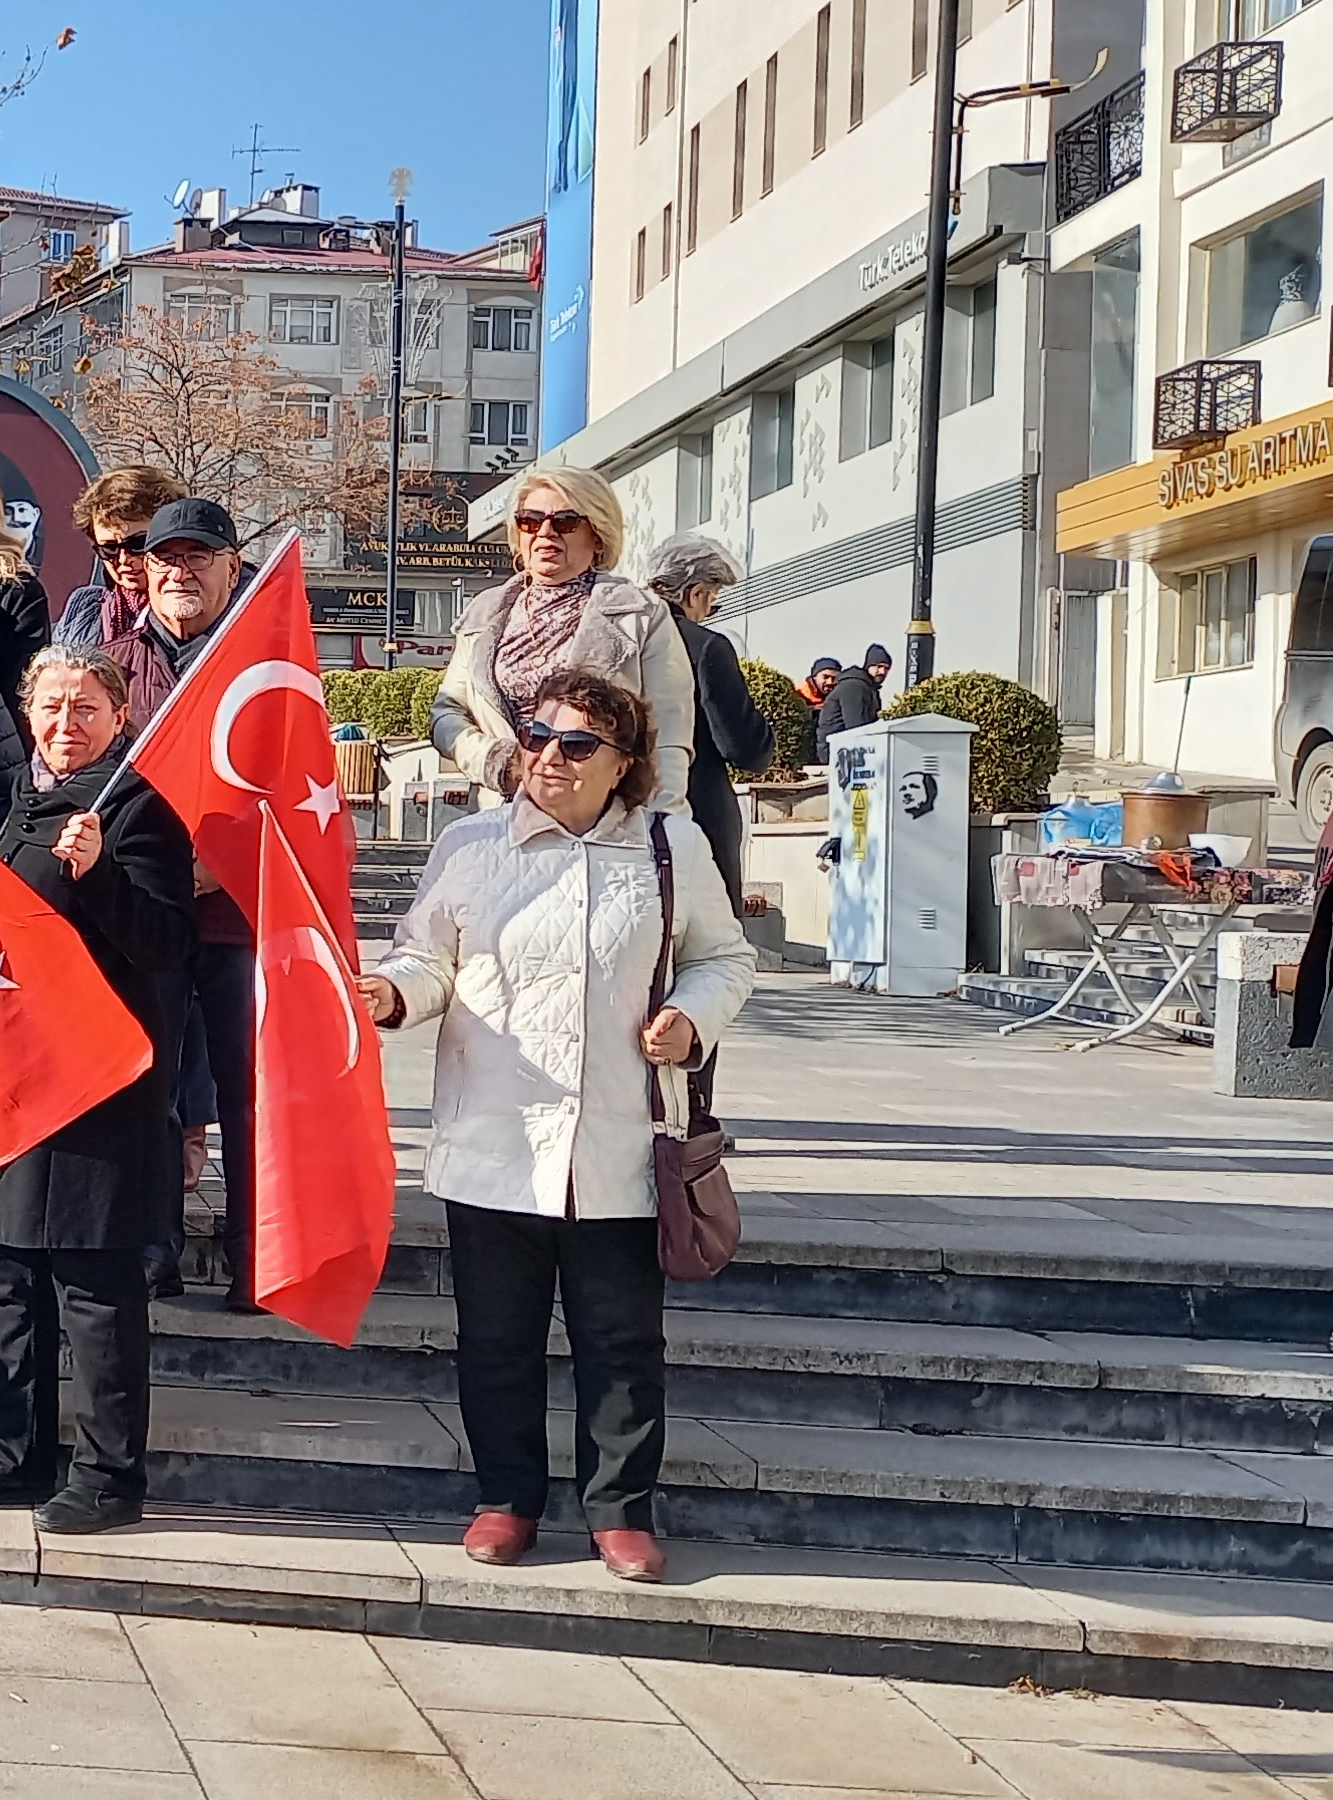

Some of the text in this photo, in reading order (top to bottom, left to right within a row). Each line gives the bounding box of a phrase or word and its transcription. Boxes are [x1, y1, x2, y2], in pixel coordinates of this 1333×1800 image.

[887, 230, 928, 273] Teleko
[1158, 418, 1332, 507] SİVAS SU ARITMA
[362, 542, 417, 551] AVUKTLIK
[346, 592, 388, 606] MCK
